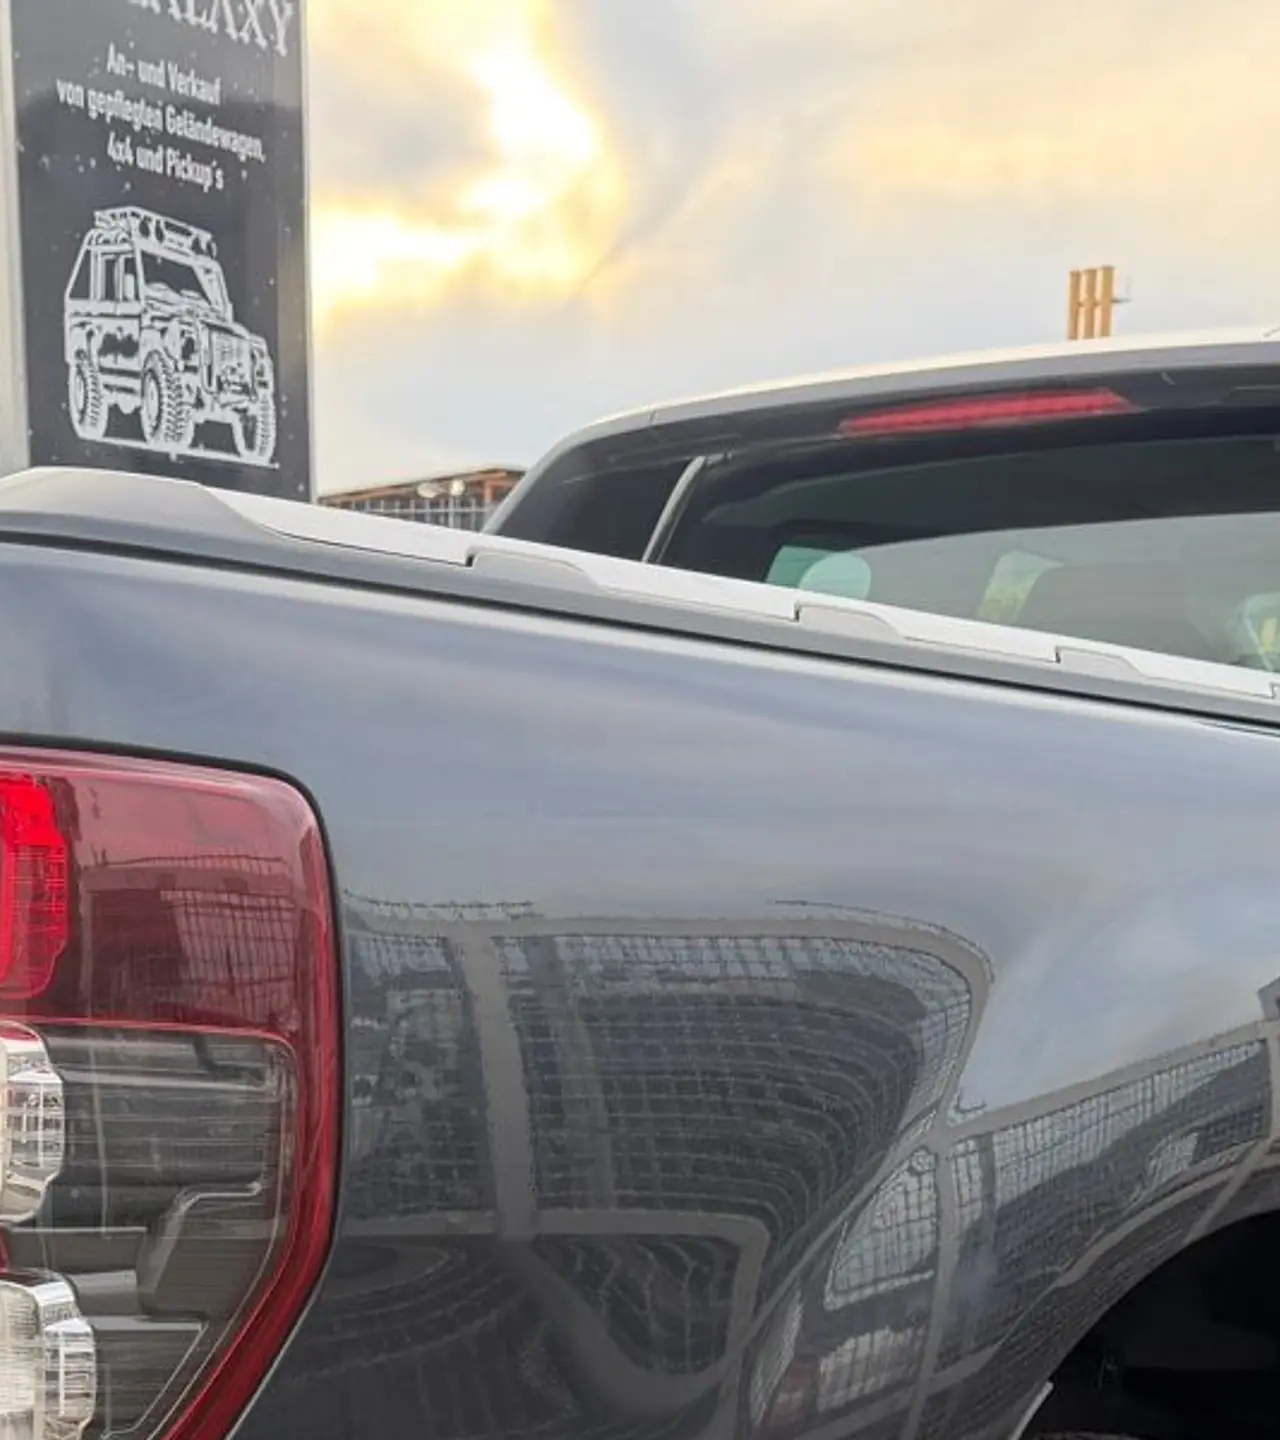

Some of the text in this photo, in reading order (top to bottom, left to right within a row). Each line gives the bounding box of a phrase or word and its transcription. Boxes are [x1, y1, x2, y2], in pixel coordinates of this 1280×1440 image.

[138, 59, 165, 89] und
[168, 61, 220, 104] Verkauf
[56, 78, 84, 108] von
[87, 87, 163, 132] gepflegten
[107, 131, 134, 166] 4x4
[137, 145, 163, 175] und
